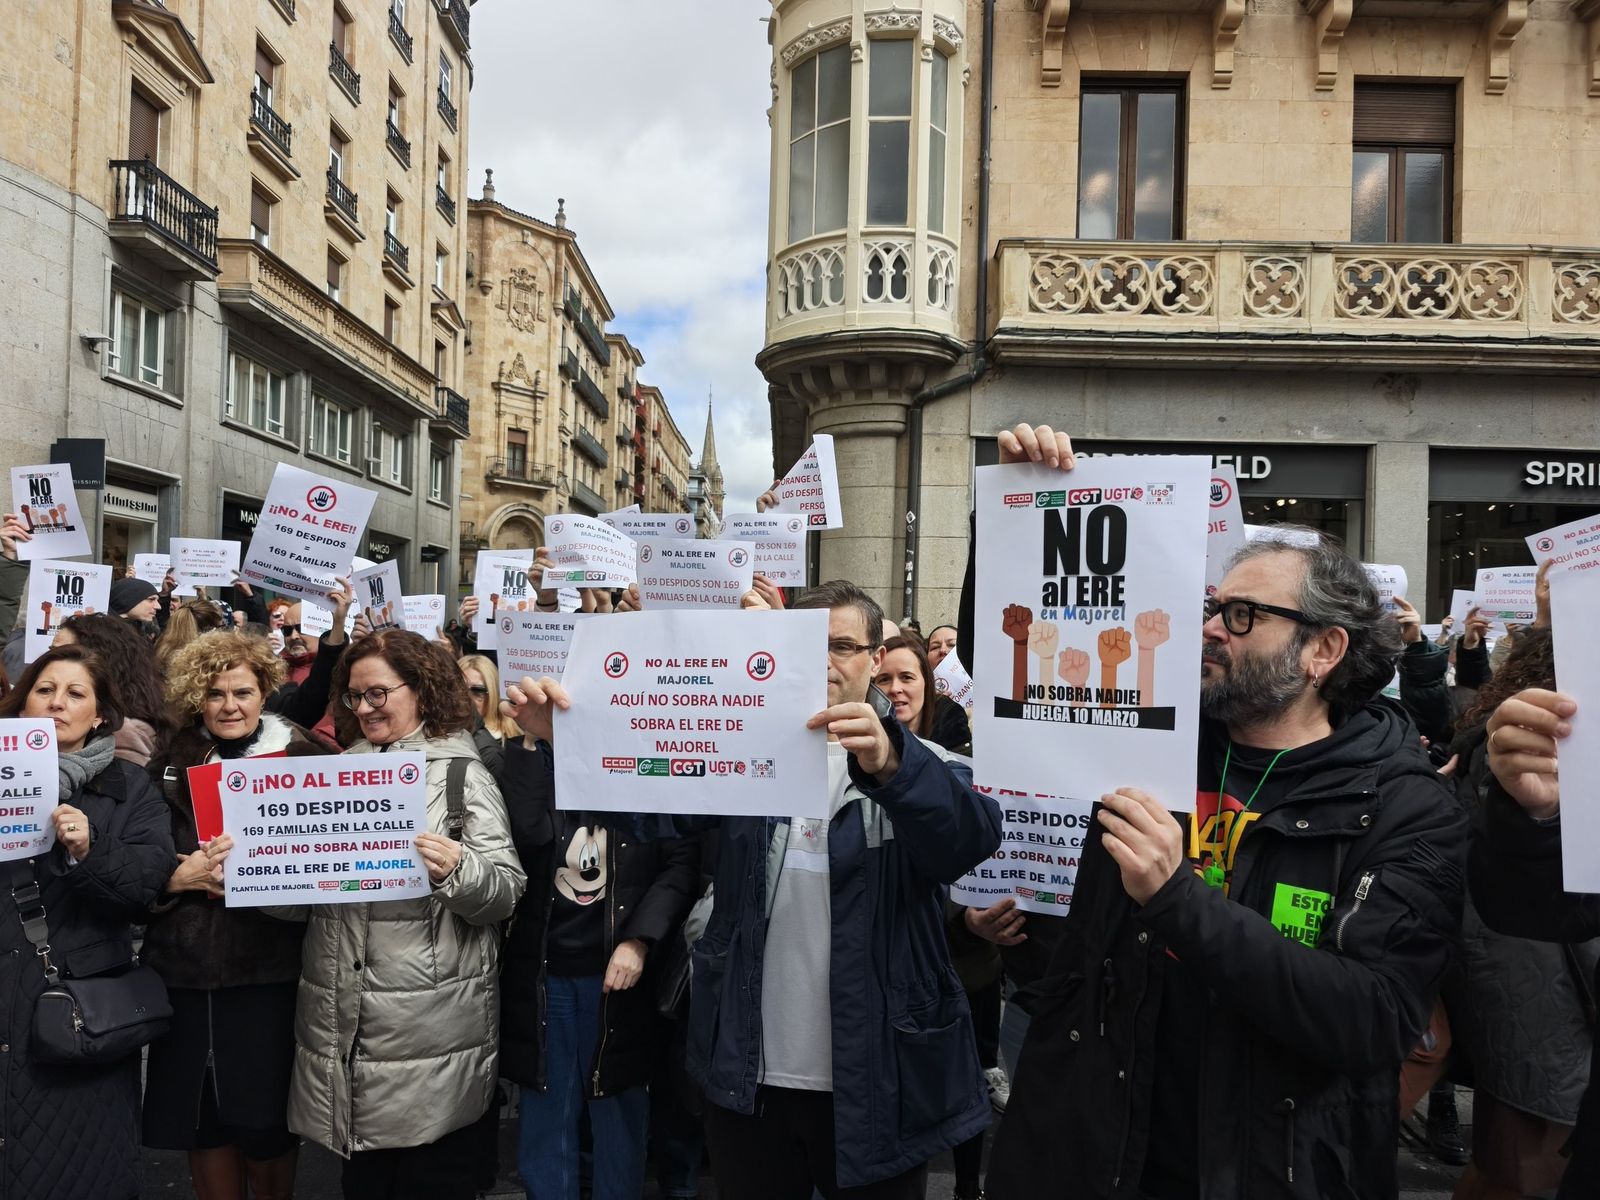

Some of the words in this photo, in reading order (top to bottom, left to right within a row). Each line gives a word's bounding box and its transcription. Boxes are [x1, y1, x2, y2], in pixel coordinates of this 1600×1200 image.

[1525, 460, 1600, 486] SPRI
[28, 477, 52, 497] NO
[40, 495, 54, 505] ERE
[782, 490, 794, 499] LOS
[1070, 490, 1100, 504] CGT
[1104, 487, 1130, 500] UGT
[800, 501, 825, 510] PERSO
[268, 504, 299, 518] ¡¡NO
[301, 512, 319, 525] AL
[323, 519, 357, 535] ERE!!
[275, 523, 293, 535] 169
[295, 529, 347, 549] DESPIDOS
[597, 528, 612, 536] ERE
[1563, 532, 1576, 540] NO
[1578, 528, 1589, 536] AL
[766, 542, 782, 550] SON
[1042, 504, 1128, 577] NO
[369, 541, 390, 555] MANGO
[554, 545, 567, 553] 169
[568, 542, 608, 553] DESPIDOS
[610, 548, 627, 559] SON
[674, 550, 685, 558] AL
[686, 550, 702, 558] ERE
[268, 545, 287, 557] 169
[289, 552, 337, 570] FAMILIAS
[558, 554, 590, 565] FAMILIAS
[591, 554, 603, 562] EN
[1551, 551, 1573, 565] AQUÍ
[1574, 548, 1590, 558] NO
[670, 562, 707, 570] MAJOREL
[252, 559, 272, 570] AQUÍ
[273, 565, 285, 574] NO
[286, 570, 312, 583] SOBRA
[313, 578, 337, 588] NADIE
[503, 570, 527, 588] NO
[586, 571, 606, 580] CGT
[56, 575, 85, 596] NO
[369, 577, 384, 598] NO
[643, 577, 658, 586] 169
[659, 578, 701, 588] DESPIDOS
[702, 580, 721, 588] SON
[724, 580, 740, 589] 169
[502, 587, 511, 596] al
[512, 588, 527, 597] ERE
[645, 592, 685, 602] FAMILIAS
[686, 593, 698, 602] EN
[700, 594, 711, 603] LA
[712, 595, 738, 604] CALLE
[1042, 576, 1068, 608] al
[1076, 576, 1126, 608] ERE
[55, 595, 65, 604] al
[67, 595, 84, 605] ERE
[1040, 607, 1058, 621] en
[1063, 603, 1127, 626] Majorel
[522, 622, 533, 630] NO
[545, 623, 561, 631] ERE
[529, 634, 566, 642] MAJOREL
[506, 648, 518, 656] 169
[520, 649, 559, 659] DESPIDOS
[508, 661, 541, 673] FAMILIAS
[542, 665, 555, 673] EN
[645, 658, 662, 668] NO
[665, 658, 681, 668] AL
[684, 658, 707, 668] ERE
[710, 658, 728, 668] EN
[656, 675, 714, 686] MAJOREL
[610, 691, 645, 707] AQUÍ
[648, 694, 669, 707] NO
[672, 694, 718, 707] SOBRA
[721, 695, 765, 707] NADIE
[1023, 684, 1046, 702] ¡NO
[1048, 685, 1092, 703] SOBRA
[1095, 687, 1141, 706] NADIE!
[1022, 705, 1071, 722] HUELGA
[1073, 708, 1088, 724] 10
[1091, 710, 1139, 728] MARZO
[630, 718, 676, 731] SOBRA
[679, 718, 694, 731] EL
[697, 719, 722, 731] ERE
[725, 719, 744, 732] DE
[655, 740, 719, 754] MAJOREL
[673, 761, 703, 775] CGT
[709, 761, 734, 773] UGT
[252, 774, 296, 794] ¡¡NO
[303, 772, 331, 788] AL
[338, 769, 393, 787] ERE!!
[0, 786, 42, 798] ALLE
[257, 803, 289, 818] 169
[296, 799, 391, 816] DESPIDOS
[242, 826, 264, 836] 169
[268, 823, 328, 836] FAMILIAS
[332, 822, 349, 833] EN
[353, 821, 370, 832] LA
[373, 820, 415, 831] CALLE
[1028, 833, 1045, 844] EN
[1049, 835, 1066, 847] LA
[249, 844, 288, 858] ¡¡AQUÍ
[291, 843, 310, 854] NO
[313, 841, 358, 853] SOBRA
[362, 839, 409, 851] NADIE!!
[1010, 850, 1054, 865] SOBRA
[237, 865, 281, 877] SOBRA
[284, 864, 300, 875] EL
[304, 863, 329, 874] ERE
[333, 862, 350, 873] DE
[355, 859, 415, 871] MAJOREL
[981, 869, 997, 879] EL
[1001, 870, 1026, 880] ERE
[1030, 871, 1046, 883] DE
[231, 884, 269, 892] PLANTILLA
[361, 880, 381, 889] CGT
